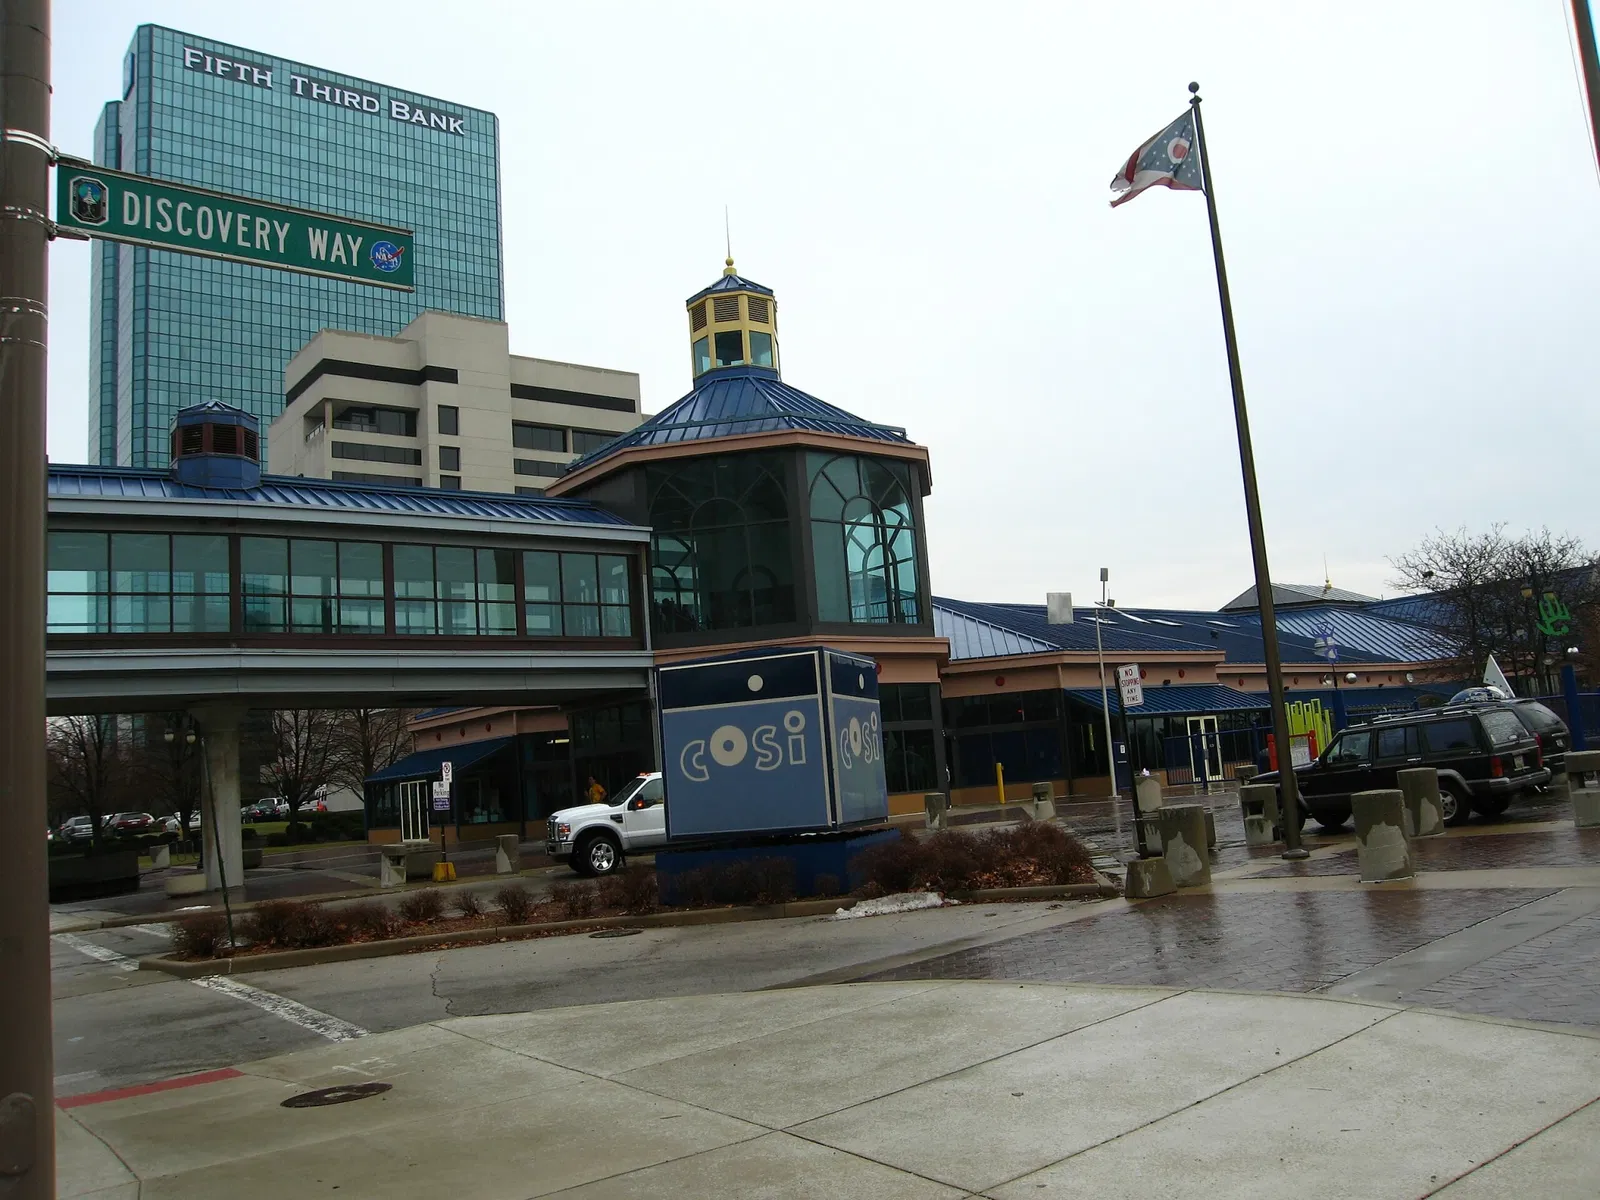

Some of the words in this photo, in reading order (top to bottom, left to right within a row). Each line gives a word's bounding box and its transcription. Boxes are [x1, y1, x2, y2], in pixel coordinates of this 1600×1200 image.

[184, 47, 273, 88] FIFTH
[290, 74, 380, 114] THIRD
[390, 99, 466, 136] BANK
[123, 190, 291, 253] DISCOVERY
[308, 226, 363, 267] WAY
[1124, 668, 1133, 677] NO
